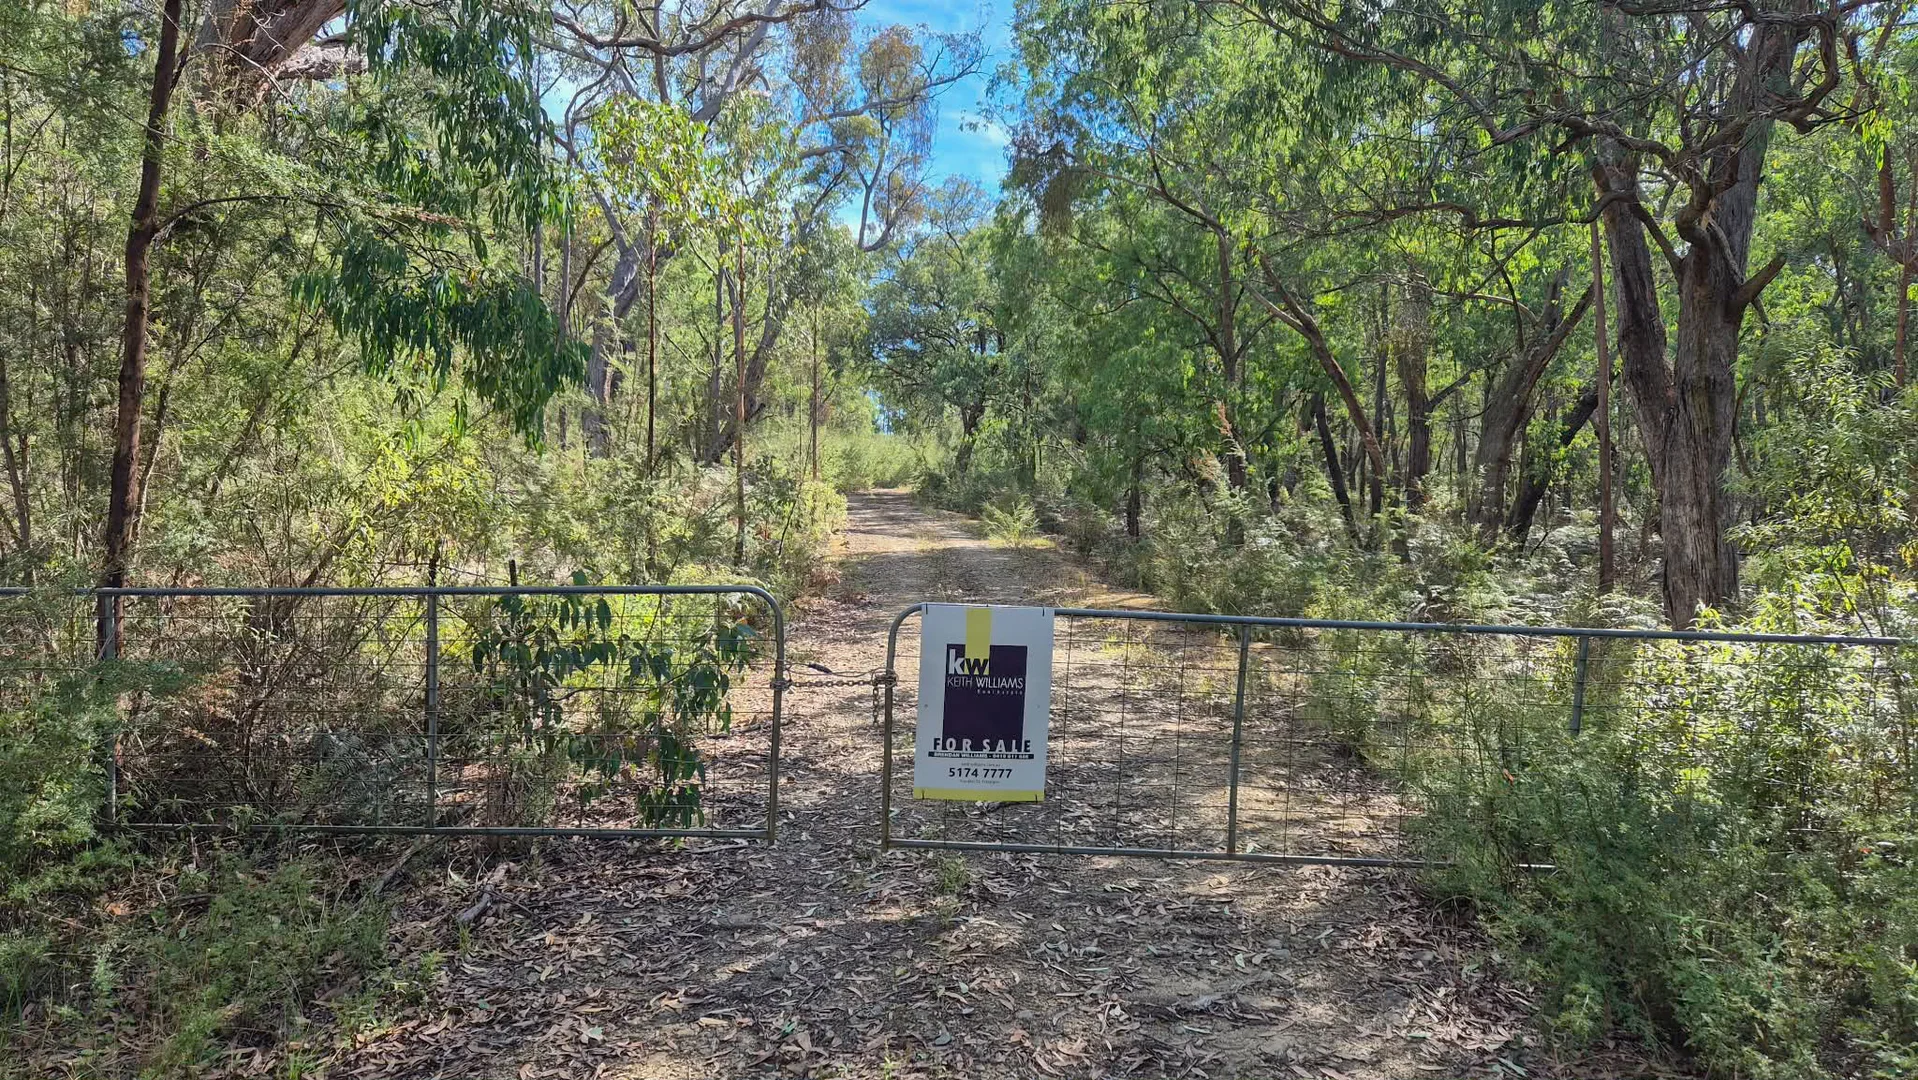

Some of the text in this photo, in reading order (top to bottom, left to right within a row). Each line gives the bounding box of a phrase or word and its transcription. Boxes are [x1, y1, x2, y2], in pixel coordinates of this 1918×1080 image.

[949, 648, 990, 676] kw
[947, 676, 1024, 689] KEITH WILLIAMS
[933, 737, 1031, 753] FOR SALE
[948, 767, 1013, 779] 5174 7777
